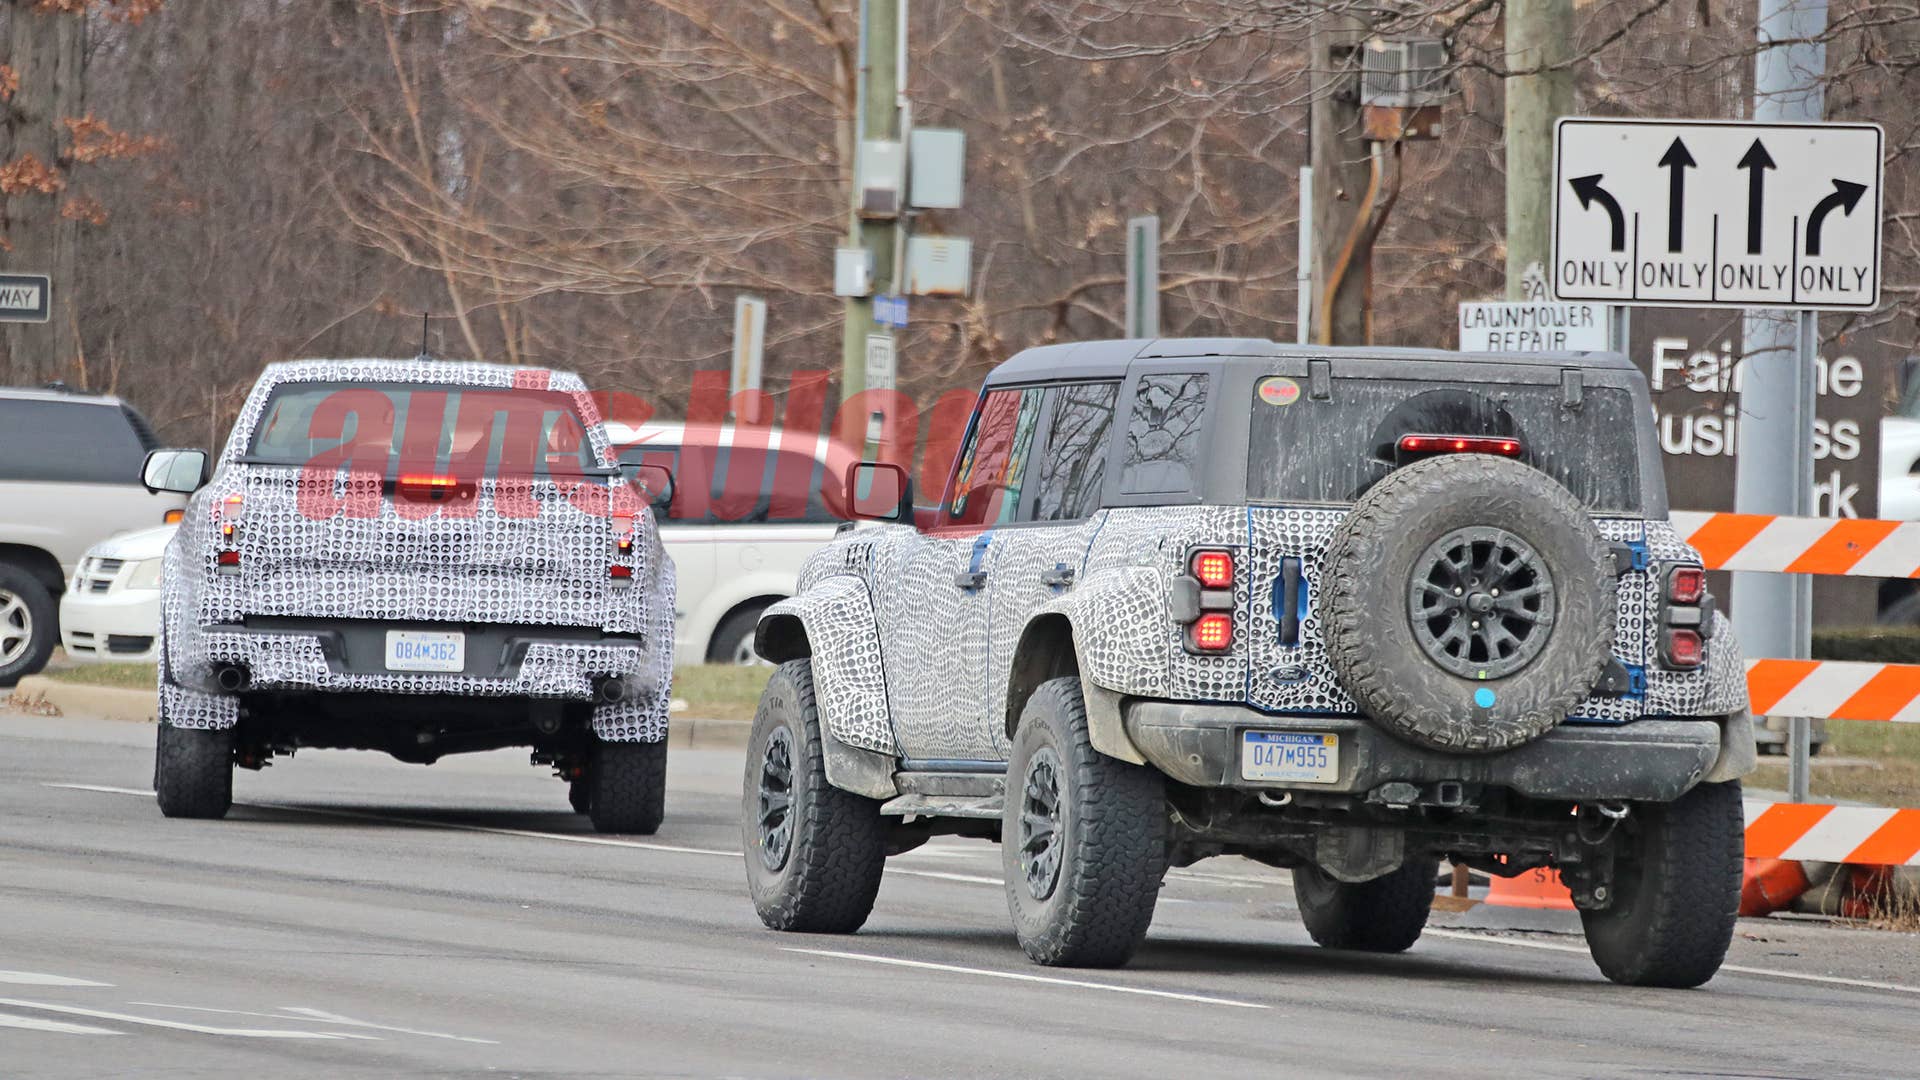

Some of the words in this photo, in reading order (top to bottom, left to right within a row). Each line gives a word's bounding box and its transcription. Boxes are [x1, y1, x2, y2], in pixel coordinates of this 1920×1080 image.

[1563, 260, 1629, 289] ONLY
[1641, 261, 1708, 288] ONLY
[1721, 263, 1787, 290] ONLY
[1801, 265, 1867, 292] ONLY
[1463, 306, 1594, 328] LAWNMOWER
[396, 641, 456, 661] 084M362
[1266, 734, 1314, 744] MICHIGAN
[1254, 744, 1327, 768] 047M955
